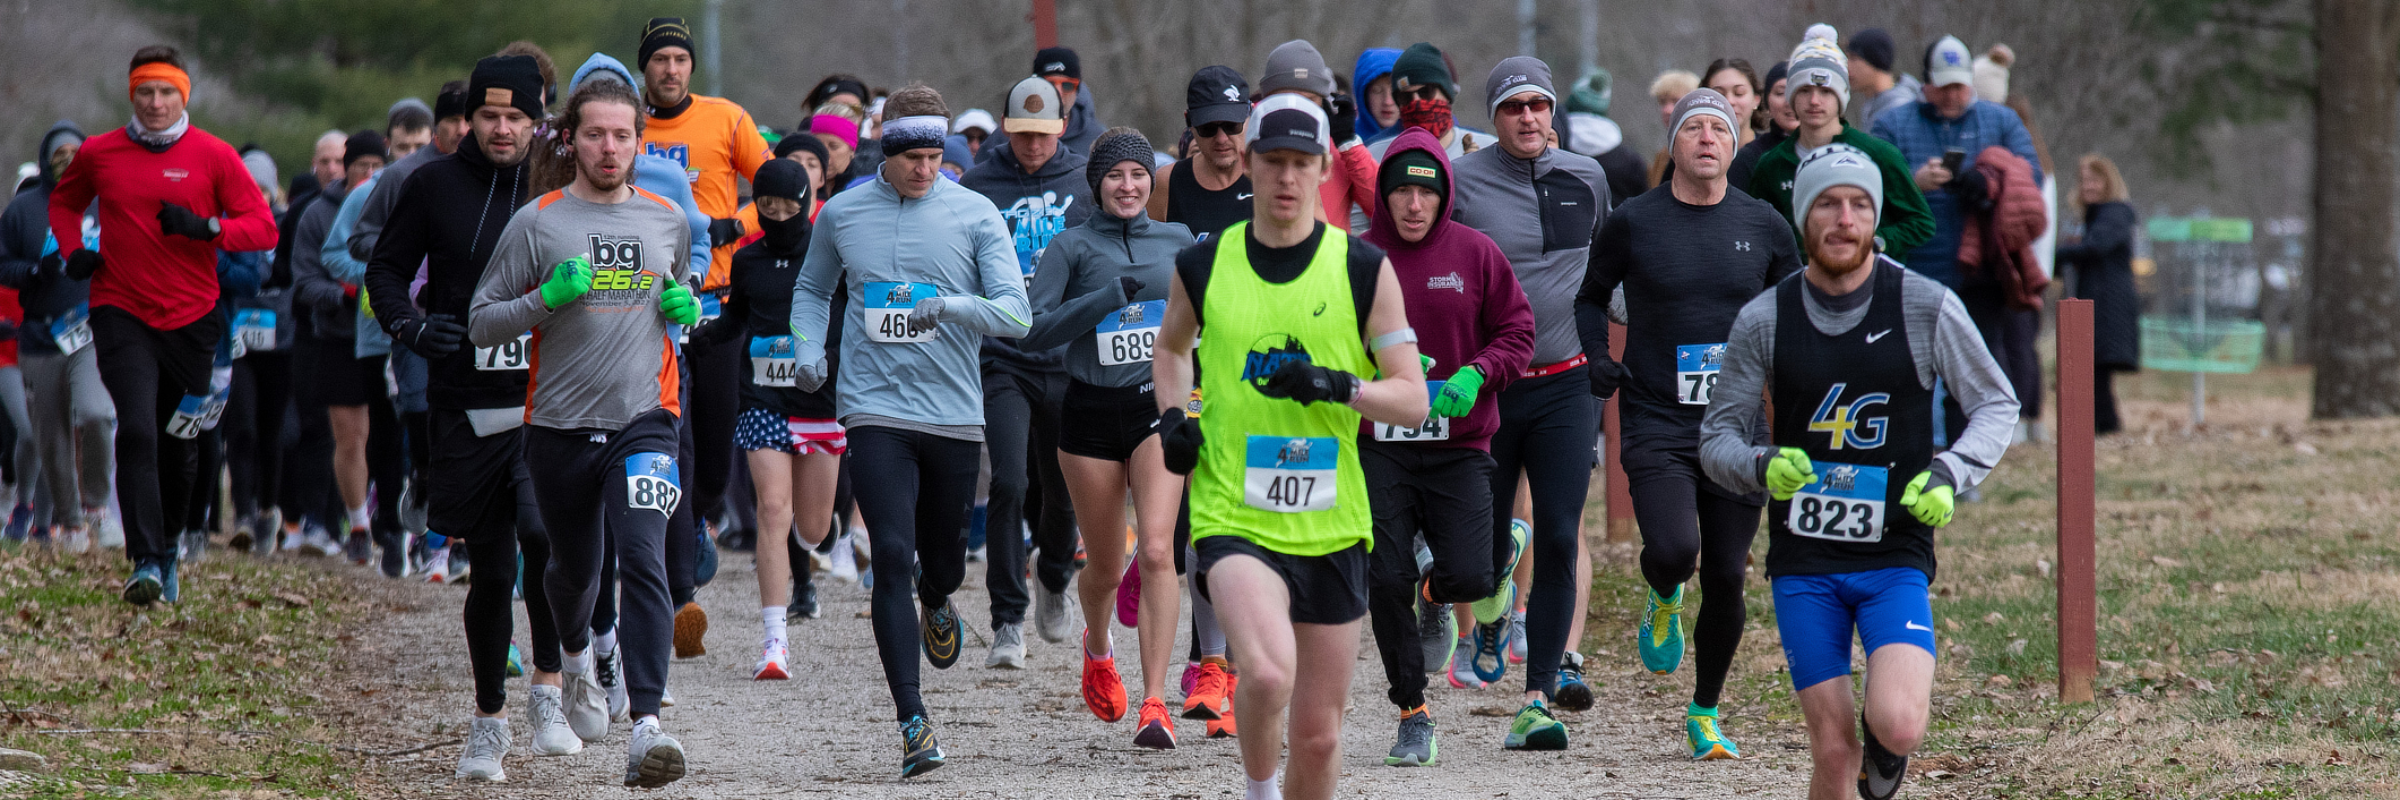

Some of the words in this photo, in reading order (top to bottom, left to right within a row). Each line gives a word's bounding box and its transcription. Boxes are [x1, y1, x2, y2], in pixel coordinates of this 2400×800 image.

[1015, 215, 1066, 236] MILE
[587, 233, 645, 274] bg
[592, 270, 654, 290] 26.2
[586, 290, 606, 300] HALF
[609, 289, 651, 300] MARATHON
[886, 291, 895, 303] 4
[1111, 331, 1155, 363] 689
[766, 362, 796, 382] 444
[1140, 382, 1155, 394] NI
[1807, 383, 1891, 450] 4G
[635, 477, 678, 517] 882
[1267, 475, 1317, 507] 407
[1797, 496, 1874, 539] 823
